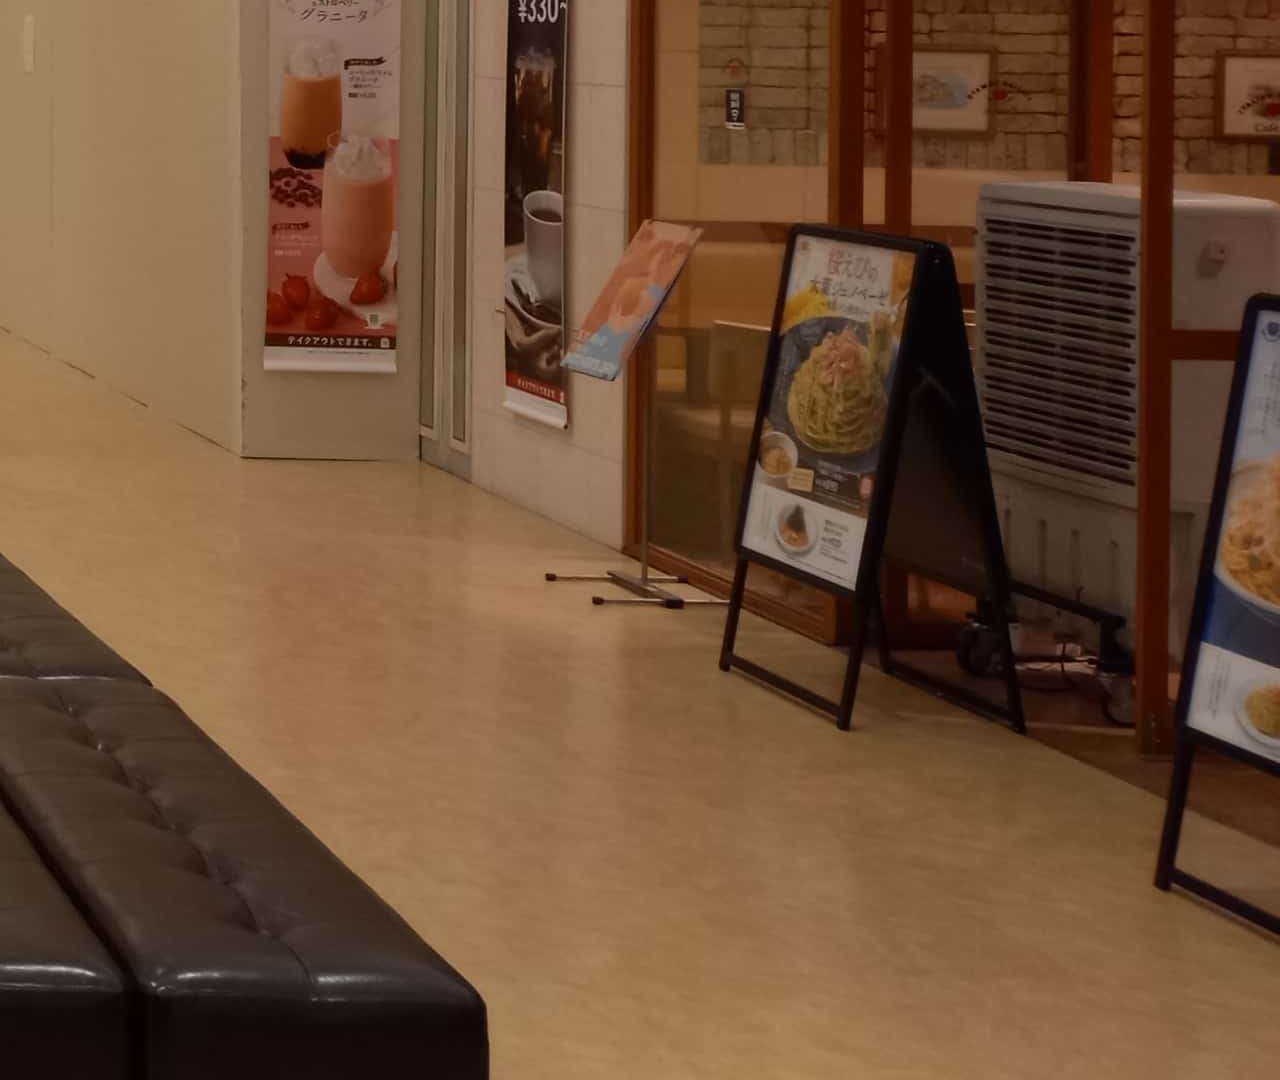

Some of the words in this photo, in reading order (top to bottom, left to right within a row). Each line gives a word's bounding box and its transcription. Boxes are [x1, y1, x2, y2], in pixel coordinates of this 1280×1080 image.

[301, 8, 368, 23] グラニータ
